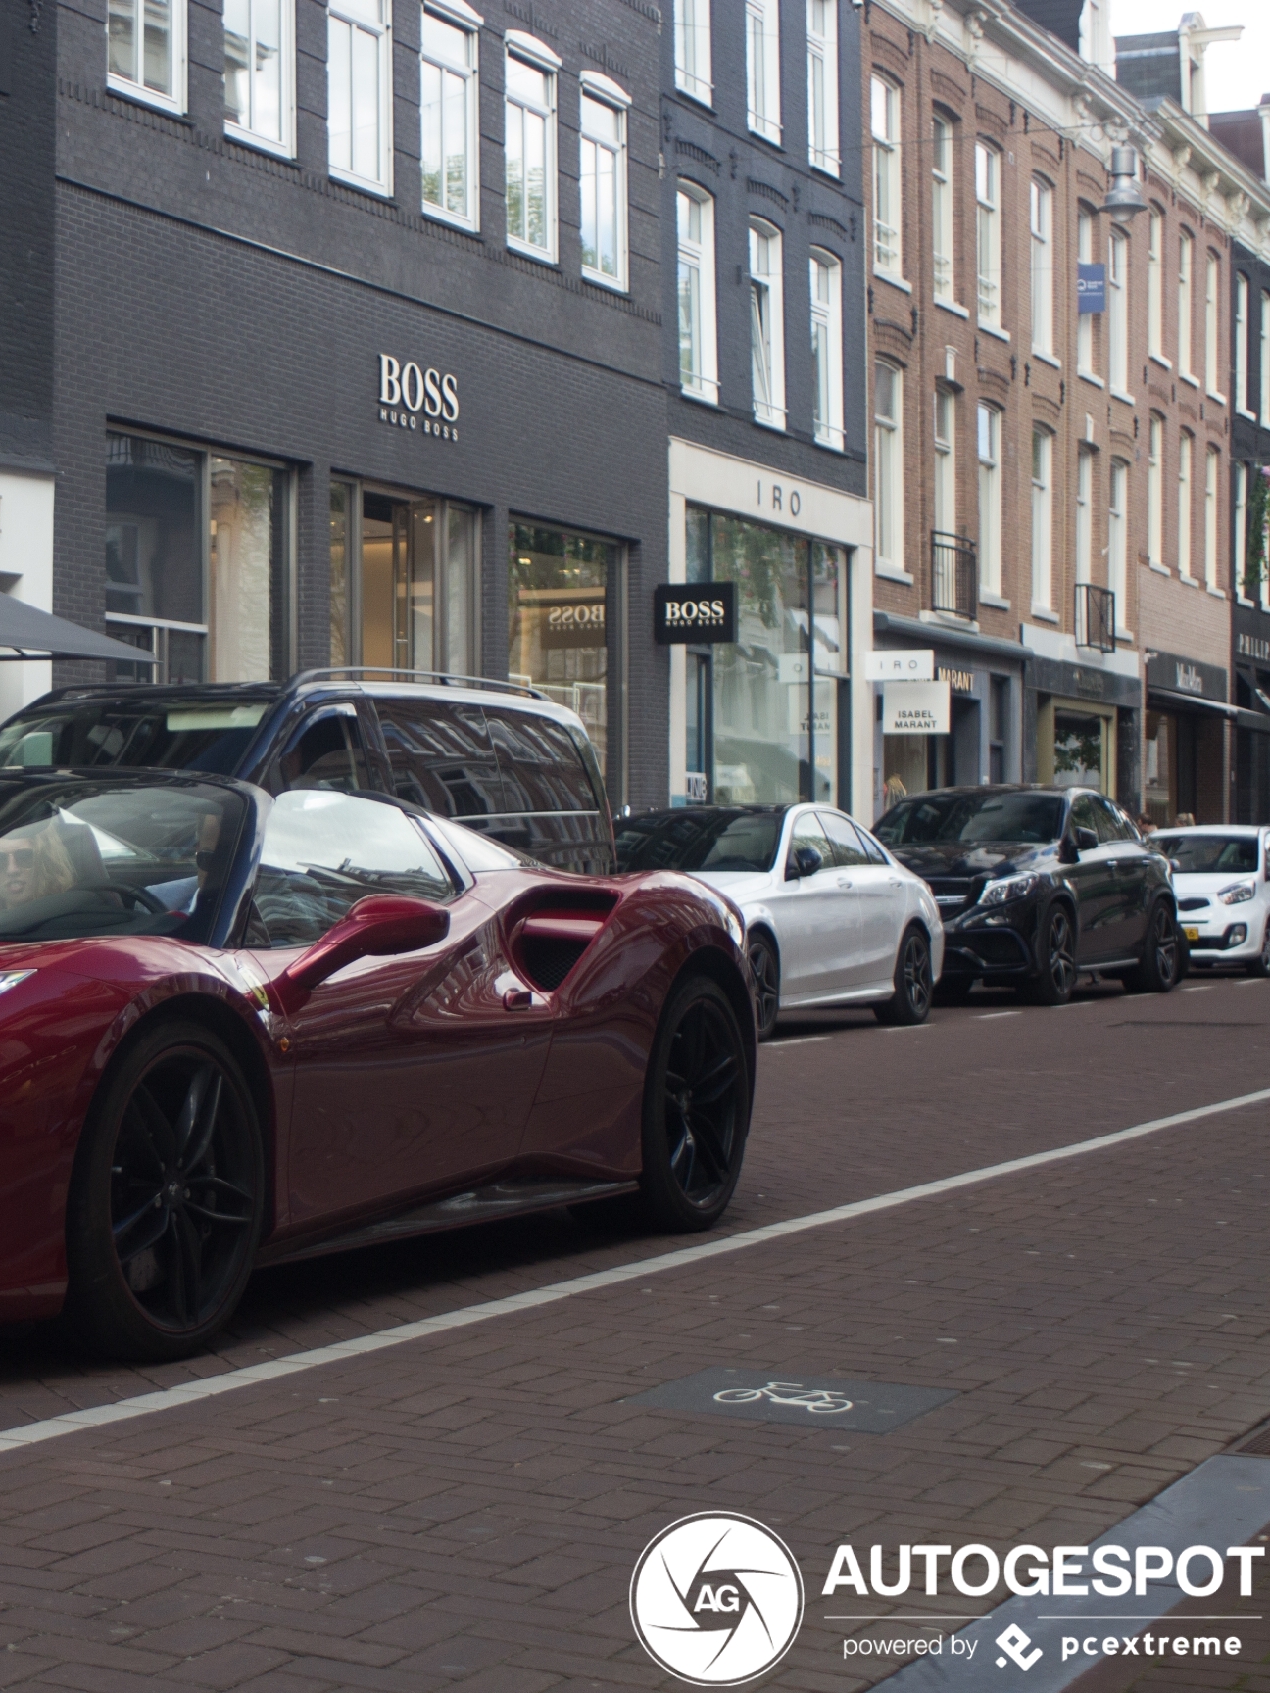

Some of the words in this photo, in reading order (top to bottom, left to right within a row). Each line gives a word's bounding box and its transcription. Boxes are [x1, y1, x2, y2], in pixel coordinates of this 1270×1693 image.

[378, 353, 460, 422] BOSS
[380, 408, 416, 430] HUGO
[423, 419, 459, 442] BOSS
[756, 479, 801, 517] IRO
[665, 600, 725, 620] BOSS
[879, 659, 918, 670] IRO
[894, 720, 937, 729] MARANT
[898, 710, 934, 719] ISABEL
